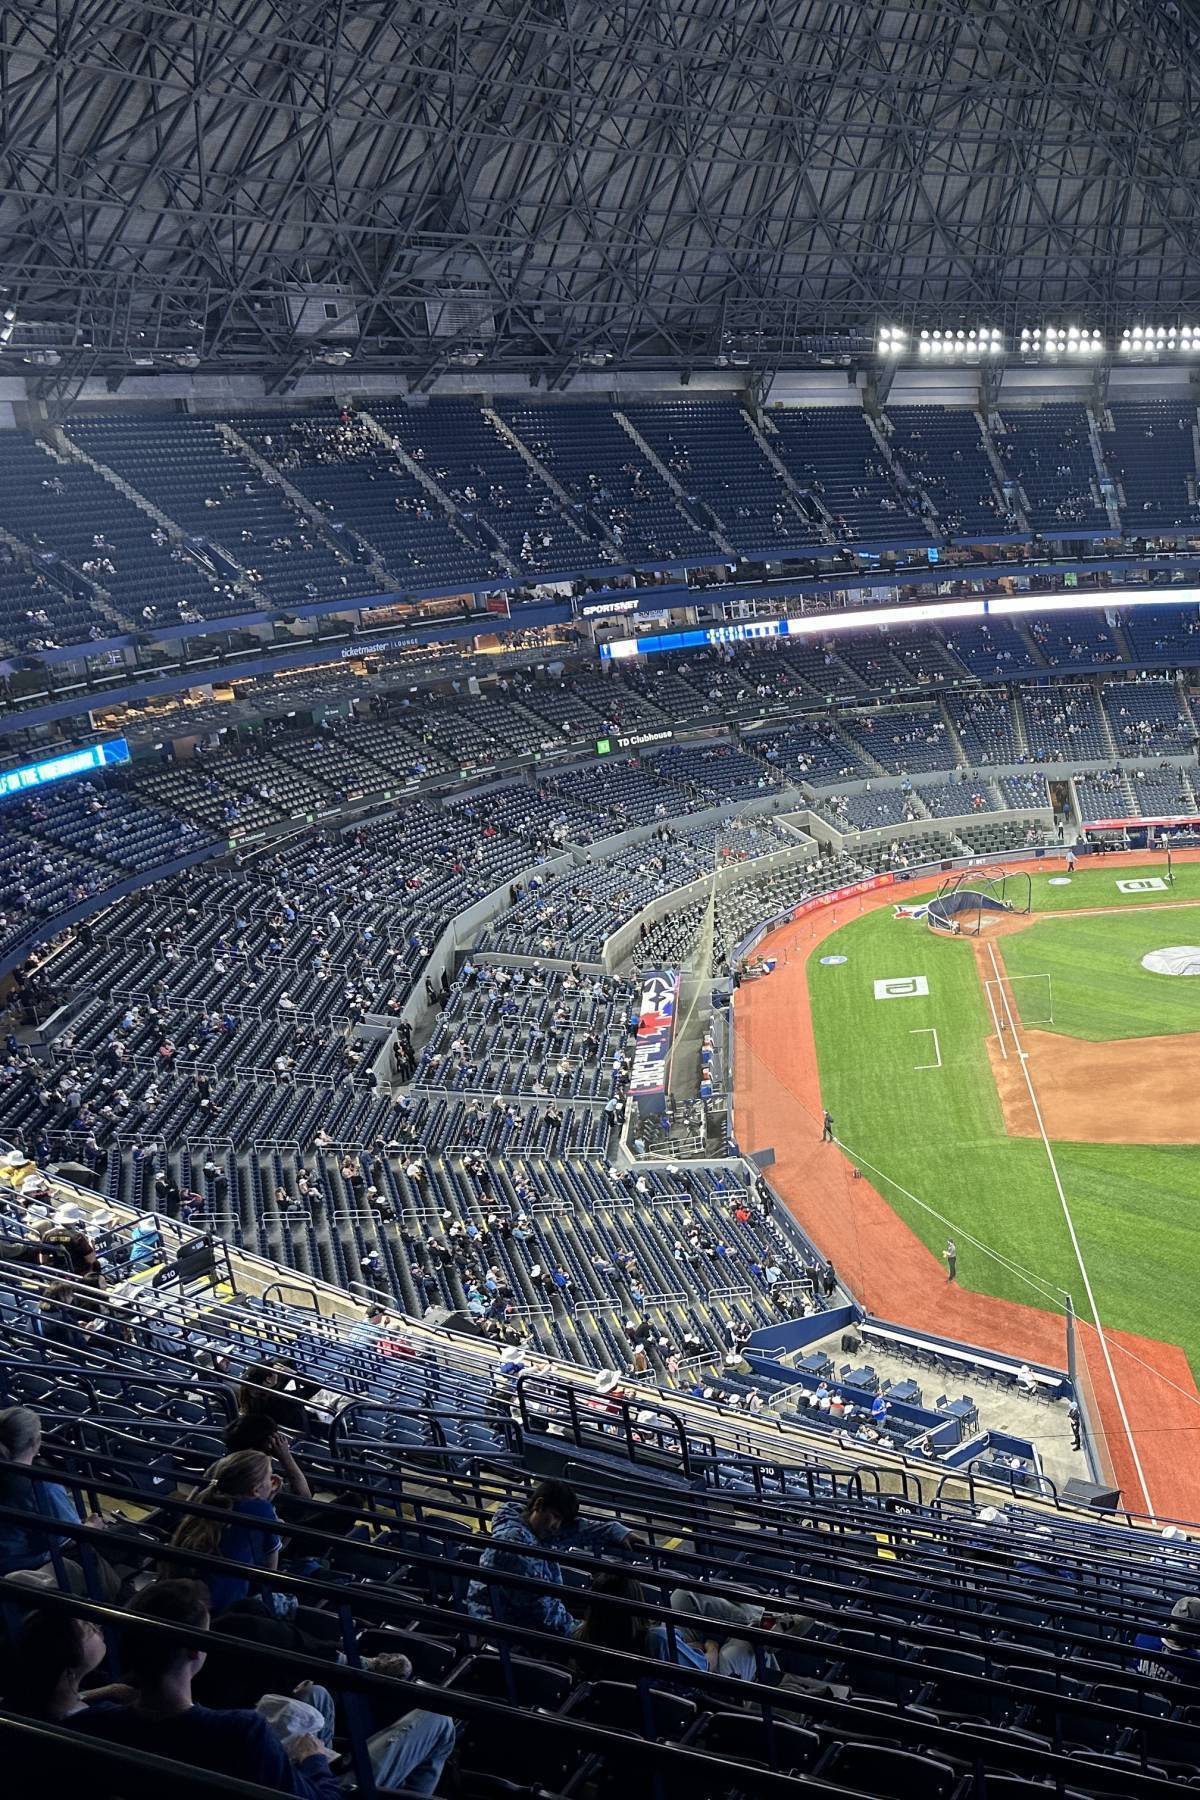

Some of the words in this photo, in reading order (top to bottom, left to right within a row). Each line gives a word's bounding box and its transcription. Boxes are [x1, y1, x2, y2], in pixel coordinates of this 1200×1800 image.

[583, 599, 639, 615] SPORTSNET
[341, 643, 387, 657] ticketmaster
[394, 638, 418, 647] LOUNGE
[617, 738, 630, 747] TD
[630, 730, 672, 745] Clubhouse
[635, 1042, 661, 1054] TO
[630, 1060, 665, 1089] CORE
[161, 1270, 176, 1282] 510
